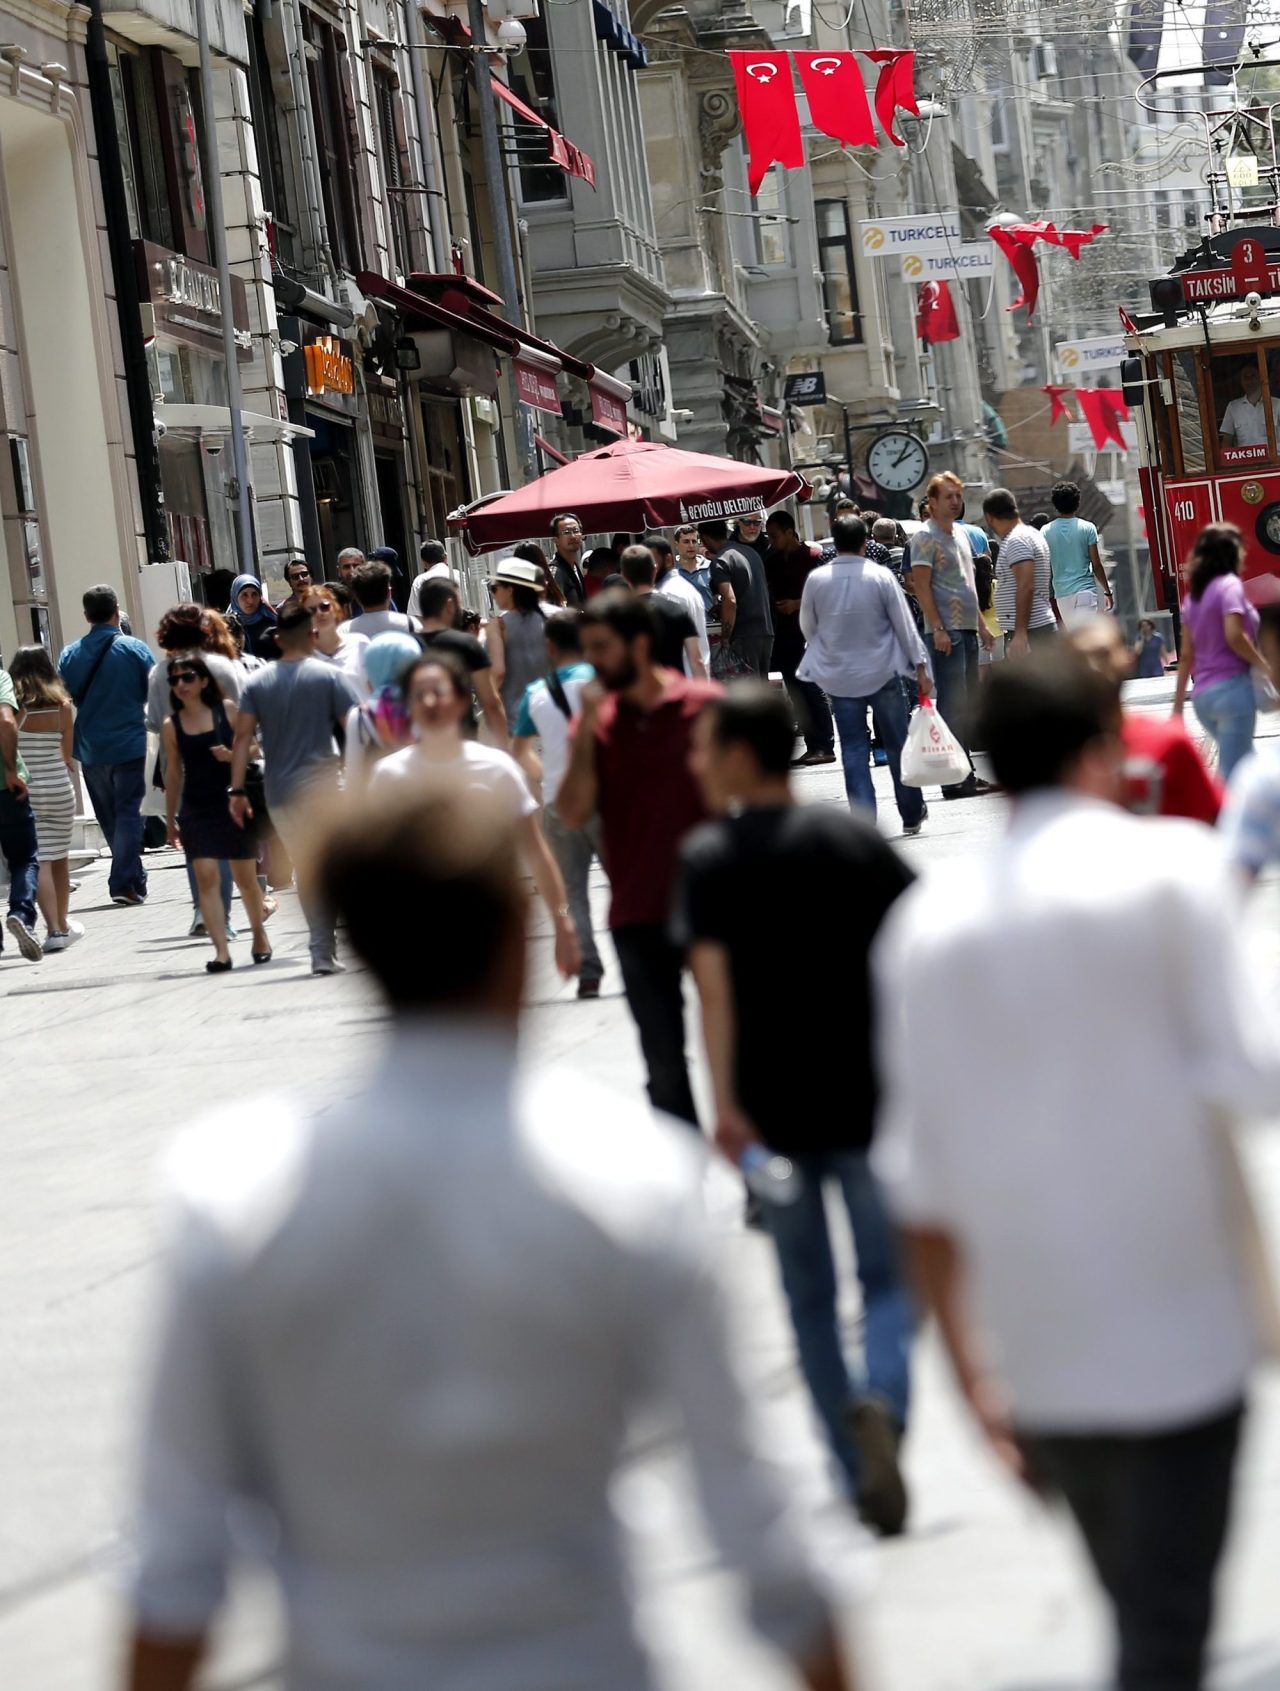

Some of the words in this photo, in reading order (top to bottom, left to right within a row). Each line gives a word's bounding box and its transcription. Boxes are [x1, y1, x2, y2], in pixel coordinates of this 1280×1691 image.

[889, 225, 960, 242] TURKCELL
[1242, 243, 1253, 263] 3
[928, 254, 992, 270] TURKCELL
[1082, 345, 1128, 360] TURKCE
[1224, 448, 1266, 460] TAKSİM
[688, 500, 723, 520] BEYOĞLU
[723, 495, 765, 515] BELEDİYESİ
[1174, 500, 1194, 521] 410
